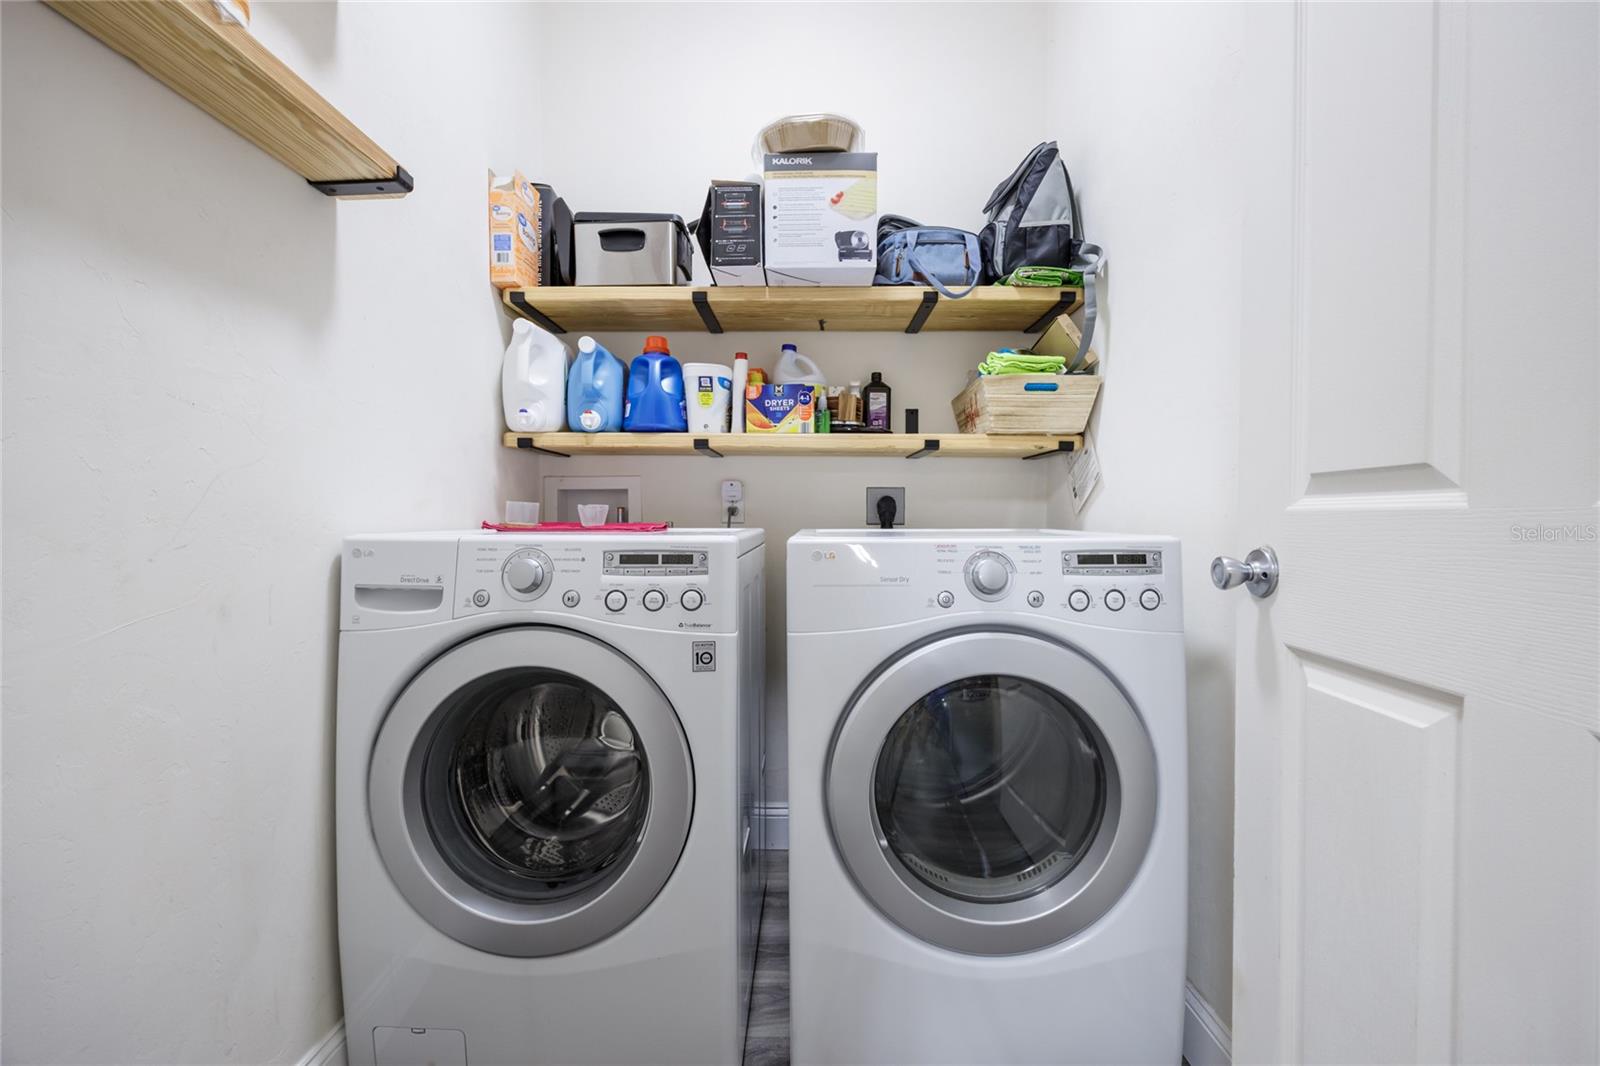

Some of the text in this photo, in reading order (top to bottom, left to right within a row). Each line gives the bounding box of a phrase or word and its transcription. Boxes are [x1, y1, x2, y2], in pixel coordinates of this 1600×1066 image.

[772, 157, 813, 165] KALORIK
[764, 399, 794, 407] DRYER
[695, 651, 713, 665] 10
